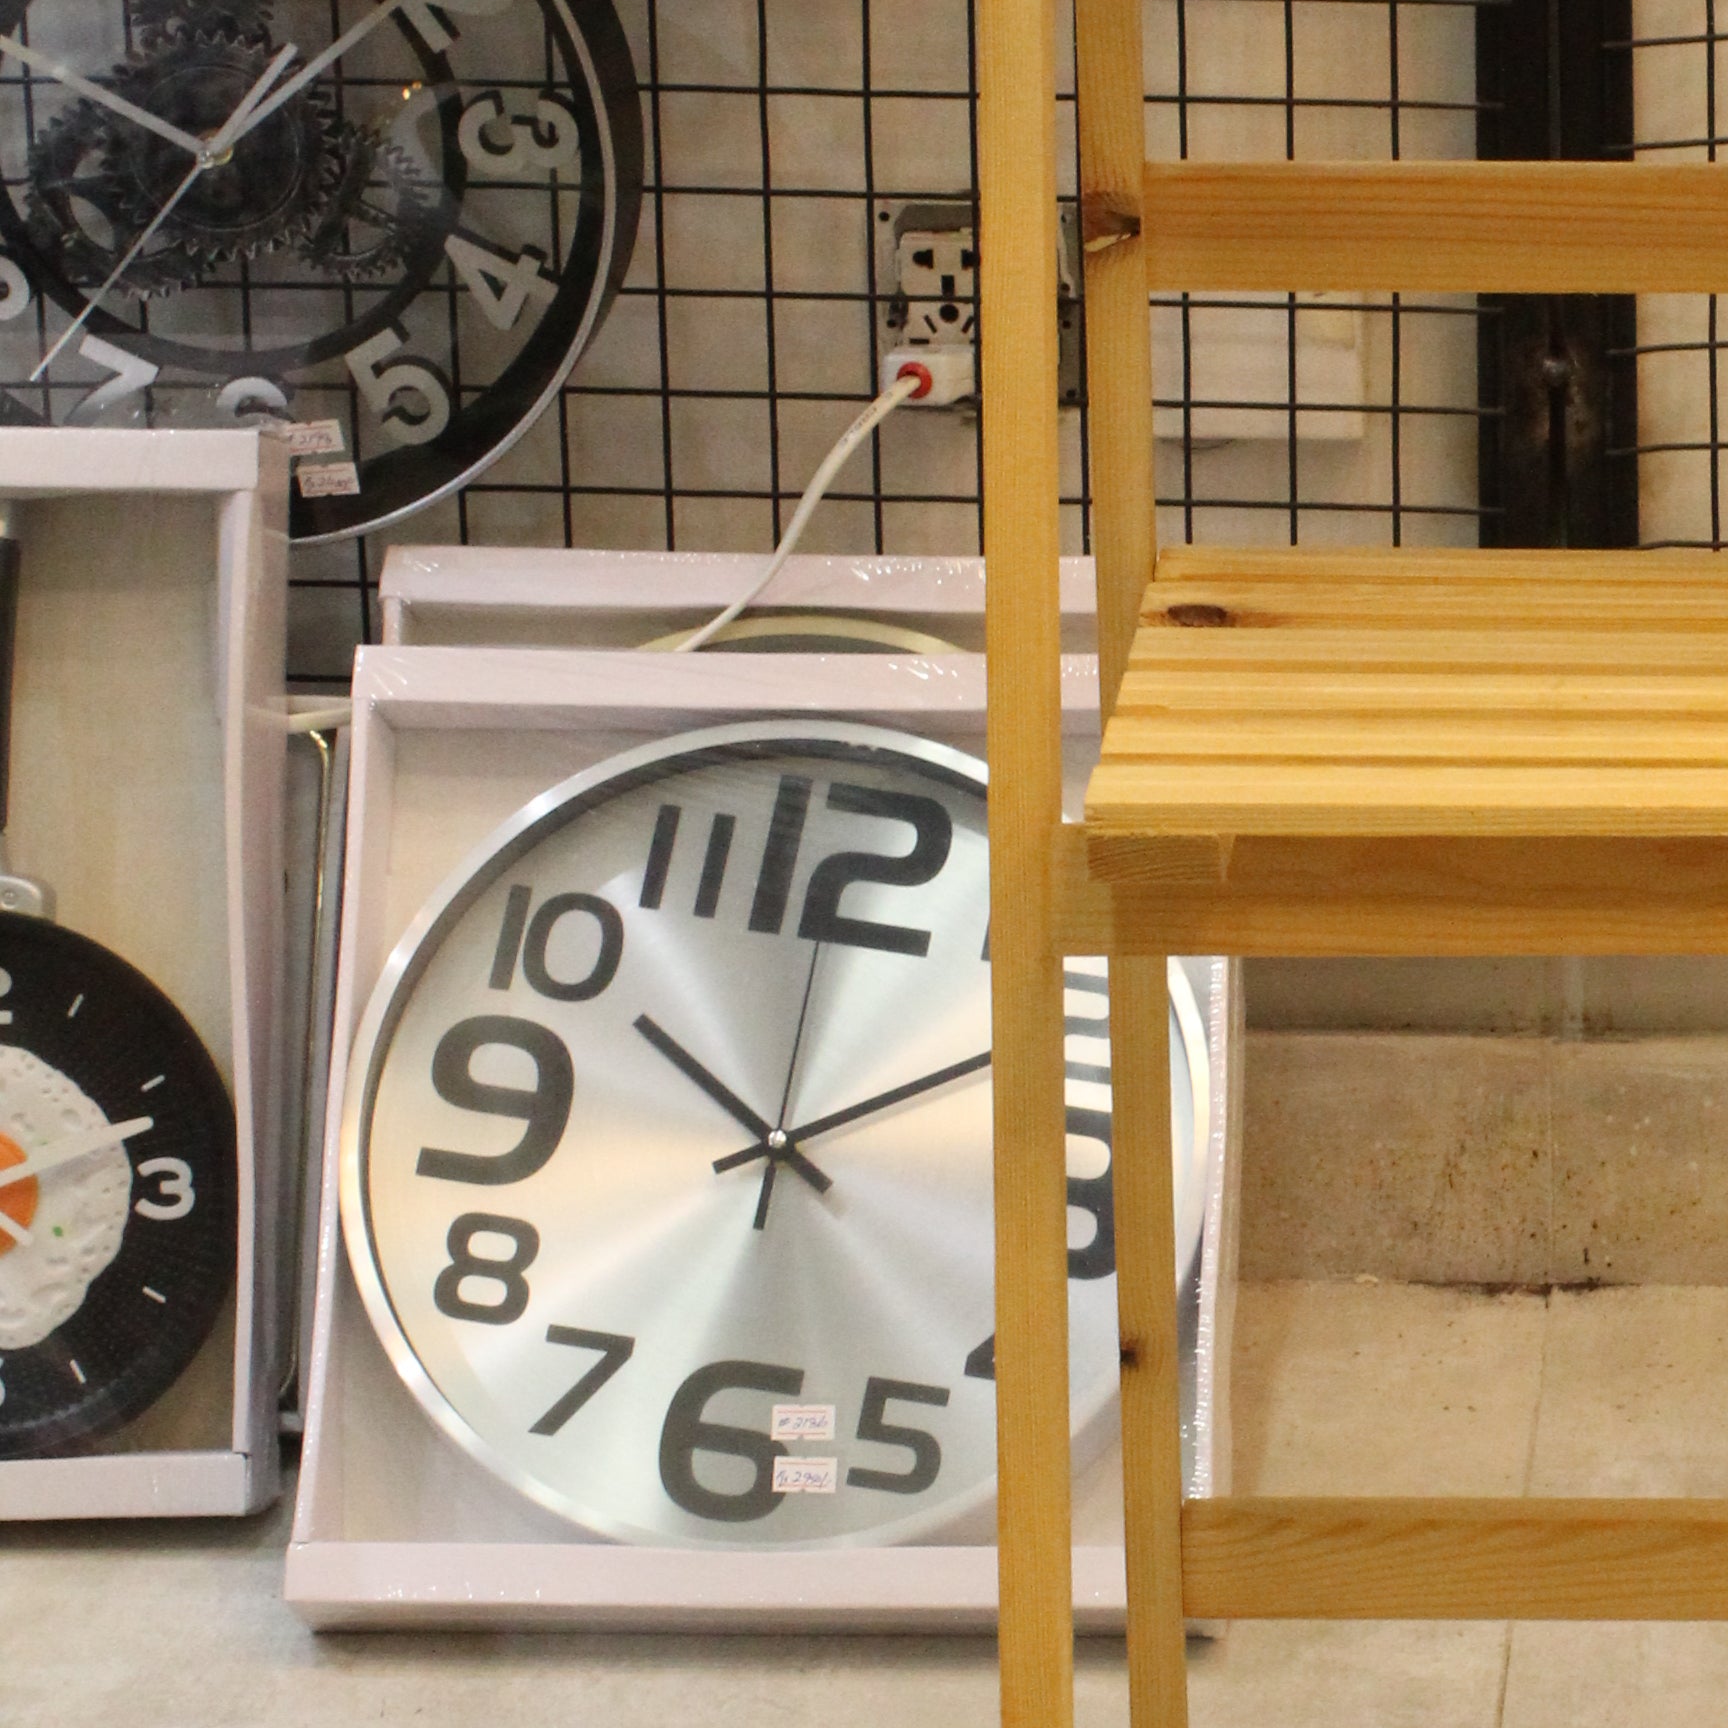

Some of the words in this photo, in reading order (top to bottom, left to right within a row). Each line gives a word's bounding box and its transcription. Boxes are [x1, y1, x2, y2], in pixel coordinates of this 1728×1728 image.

[458, 88, 579, 172] 3
[443, 233, 559, 332] 4
[345, 324, 450, 447] 5
[637, 804, 737, 919] 11
[748, 774, 954, 958] 12
[487, 883, 625, 1003] 10
[415, 1013, 575, 1187] 9
[134, 1156, 196, 1221] 3
[432, 1210, 541, 1326] 8
[527, 1322, 636, 1438] 7
[845, 1375, 951, 1495] 5
[657, 1358, 806, 1524] 6
